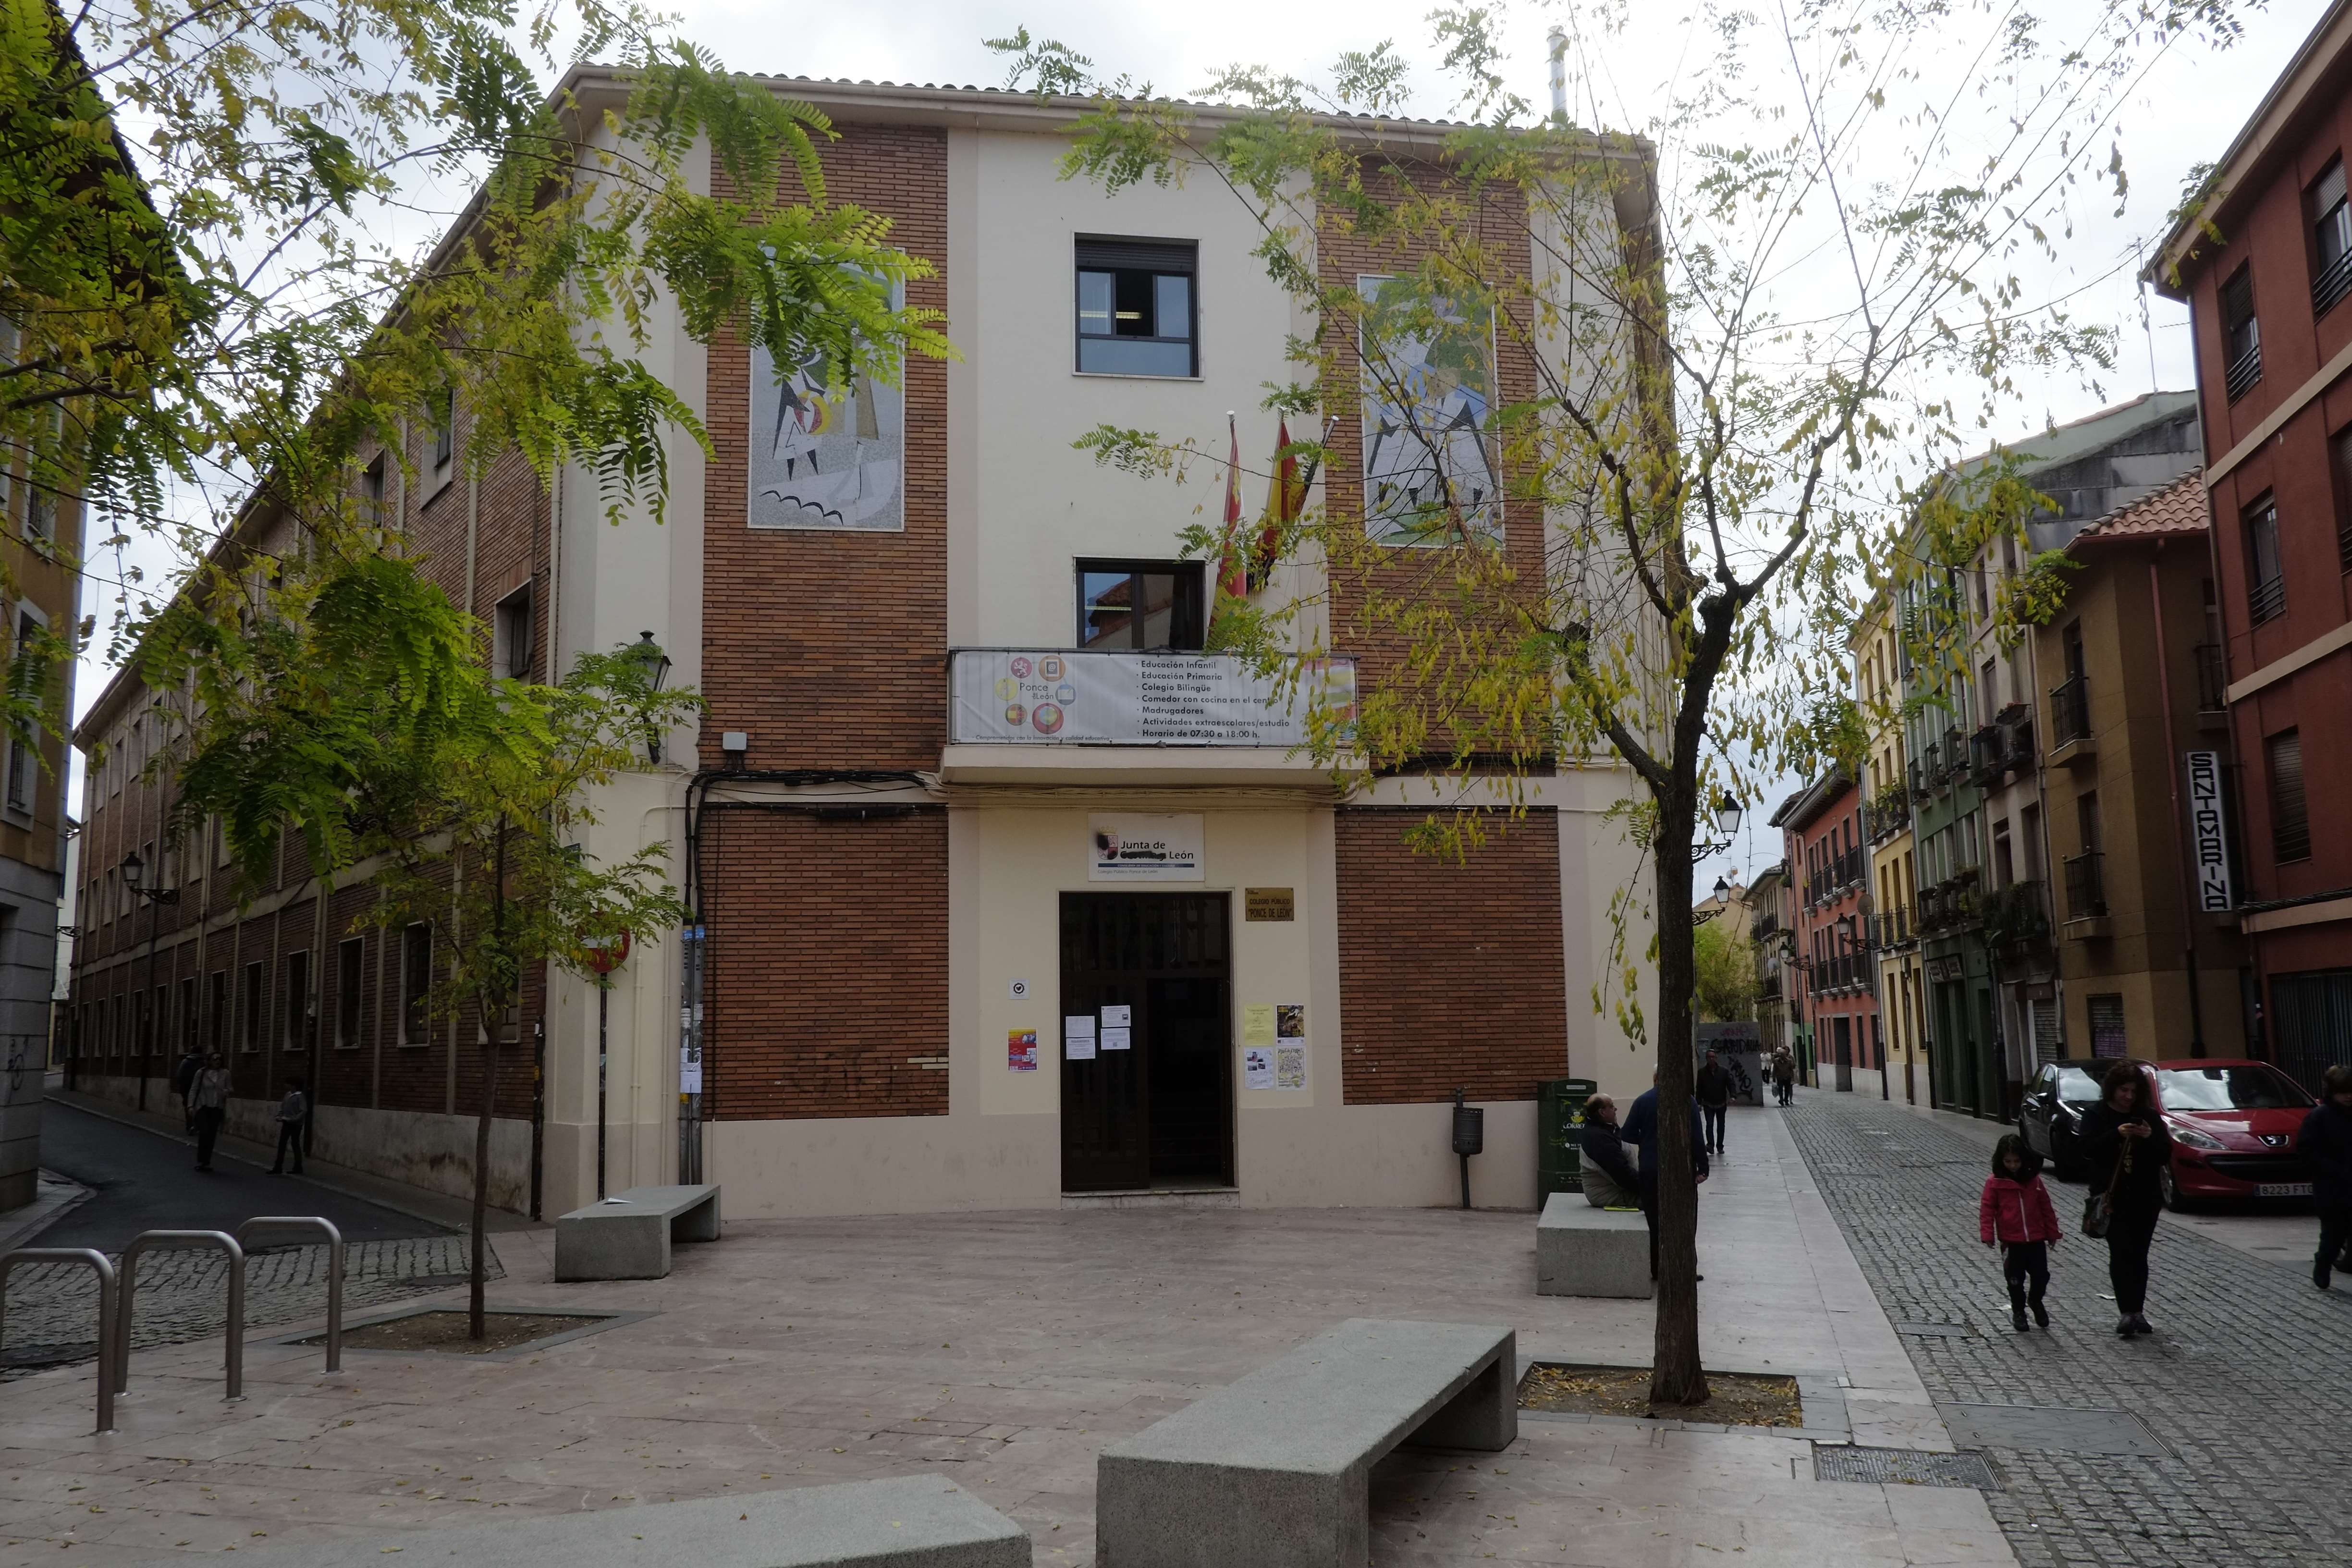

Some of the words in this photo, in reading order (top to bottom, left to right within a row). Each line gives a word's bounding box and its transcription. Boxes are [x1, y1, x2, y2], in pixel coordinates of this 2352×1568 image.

[1141, 672, 1184, 680] Educación
[1019, 683, 1048, 691] Ponce
[1142, 683, 1174, 692] Colegio
[1177, 684, 1211, 693] Bilingüe
[1142, 706, 1204, 715] Madrugadores
[1142, 718, 1192, 726] Actividades
[1195, 719, 1290, 728] extraescolares/estudio
[2191, 753, 2228, 909] SANTAMARINA
[1169, 851, 1193, 859] León
[1269, 908, 1275, 918] DE
[2263, 1185, 2290, 1195] 8223
